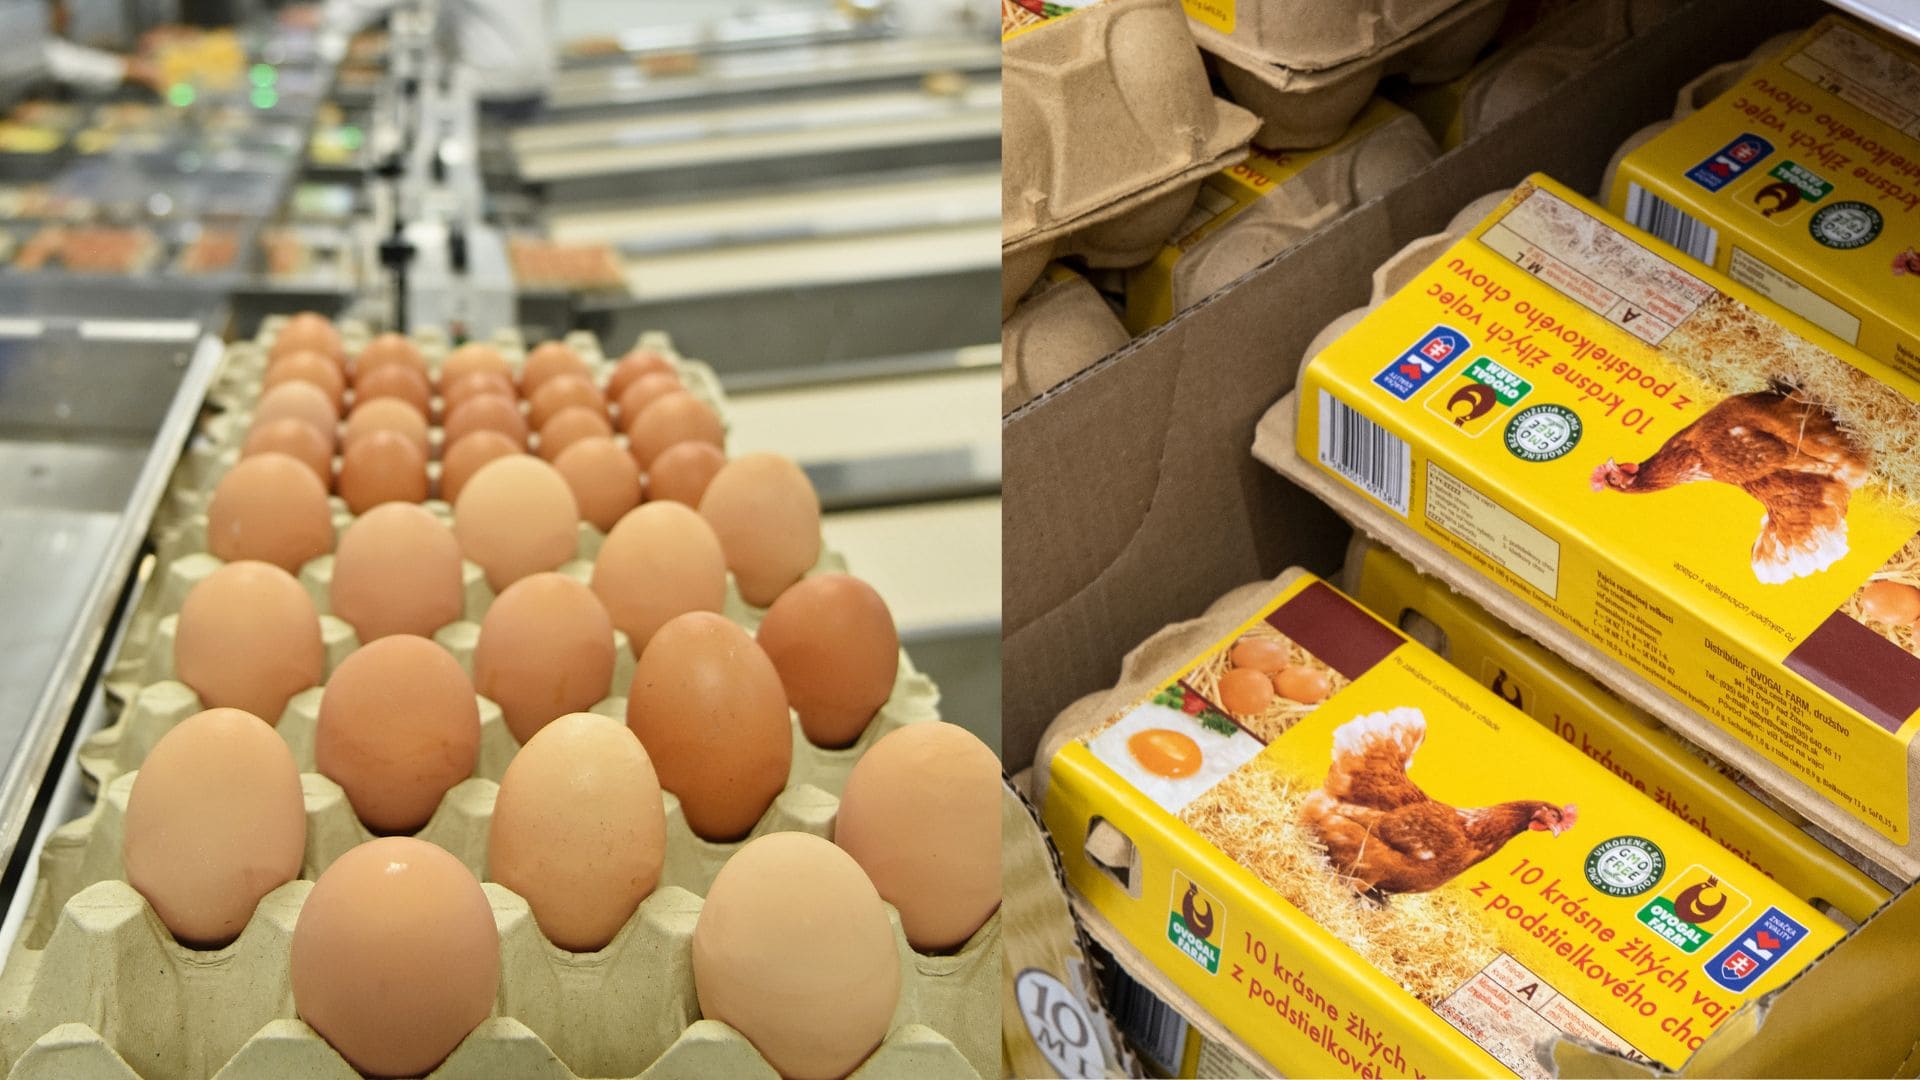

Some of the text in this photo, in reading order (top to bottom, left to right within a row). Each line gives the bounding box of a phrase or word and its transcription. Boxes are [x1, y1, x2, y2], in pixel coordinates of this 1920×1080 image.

[1751, 77, 1812, 115] chovu
[1733, 97, 1786, 133] vajec
[1789, 130, 1852, 171] žltých
[1516, 251, 1543, 273] M L
[1447, 259, 1511, 303] chovu
[1622, 307, 1641, 324] A
[1426, 283, 1654, 435] 10 krásne žltých vajec
[1514, 301, 1677, 398] podstielkového
[1473, 365, 1519, 399] OVOGAL
[1486, 362, 1522, 388] FARM
[1672, 394, 1692, 410] z
[1520, 429, 1549, 451] GMO
[1528, 419, 1561, 443] FREE
[1597, 570, 1615, 587] Vajcia
[1704, 638, 1849, 737] Distribútor: OVOGAL FARM, družstvo
[1554, 714, 1575, 744] 10
[1582, 733, 1646, 794] krásne
[1606, 856, 1640, 881] FREE
[1619, 848, 1648, 871] GMO
[1651, 850, 1662, 872] BEZ
[1172, 919, 1215, 963] OVOGAL
[1510, 858, 1544, 885] 10
[1539, 879, 1616, 942] krásne
[1616, 937, 1689, 993] žltých
[1648, 917, 1687, 947] FARM
[1650, 905, 1702, 944] OVOGAL
[1764, 921, 1792, 941] KVALITY
[1768, 915, 1797, 937] ZNAČKA
[1177, 935, 1208, 968] FARM
[1470, 881, 1492, 897] z
[1484, 894, 1657, 1017] podstielkového
[1231, 964, 1244, 983] z
[1245, 931, 1267, 964] 10
[1274, 953, 1338, 1021] krásne
[1345, 1012, 1406, 1074] žltých
[1516, 983, 1538, 1000] A
[1030, 979, 1089, 1048] 10
